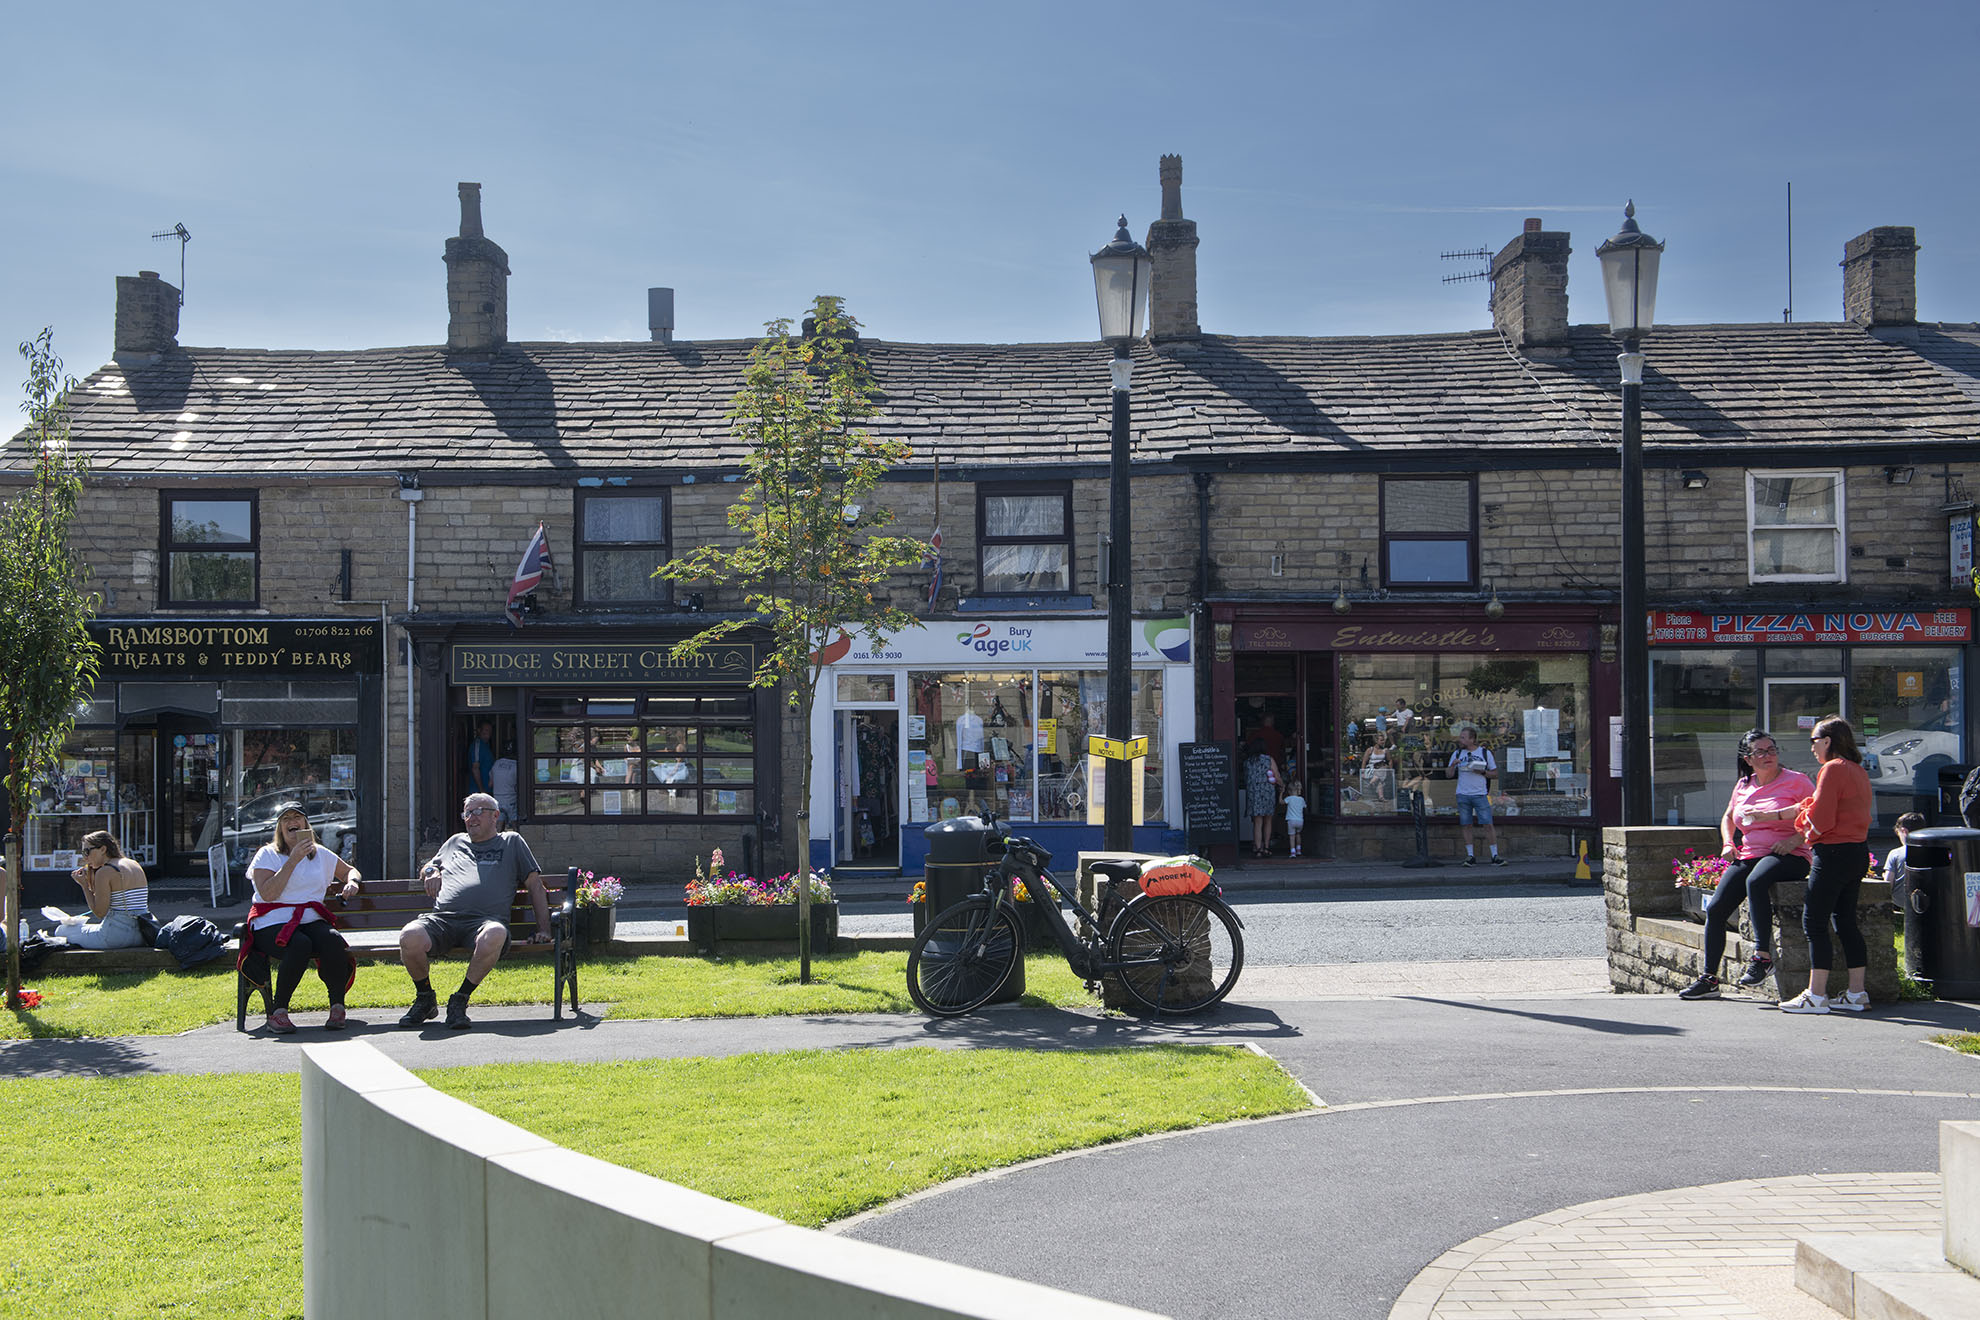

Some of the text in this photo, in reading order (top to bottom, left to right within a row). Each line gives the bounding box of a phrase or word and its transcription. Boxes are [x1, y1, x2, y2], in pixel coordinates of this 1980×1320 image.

[1666, 614, 1692, 625] Phone
[1711, 613, 1922, 632] PIZZA NOVA
[1933, 612, 1957, 624] FREE
[295, 626, 374, 638] 01706 822 166
[1010, 627, 1032, 638] Bury
[1330, 627, 1497, 647] Entwistle's
[1654, 628, 1674, 640] 1706
[1714, 632, 1904, 642] CHICKEN KEBABS PIZZAS BURGERS
[1925, 626, 1967, 637] DELIVERY
[108, 627, 268, 650] RAMSBOTTOM
[112, 652, 186, 670] TREATS
[198, 652, 208, 666] &
[222, 648, 285, 666] TEDDY
[292, 652, 352, 670] BEARS
[462, 650, 718, 669] BRIDGE STREET CHIPPY
[1414, 688, 1468, 712] COOKED
[1098, 748, 1115, 756] NOTICE
